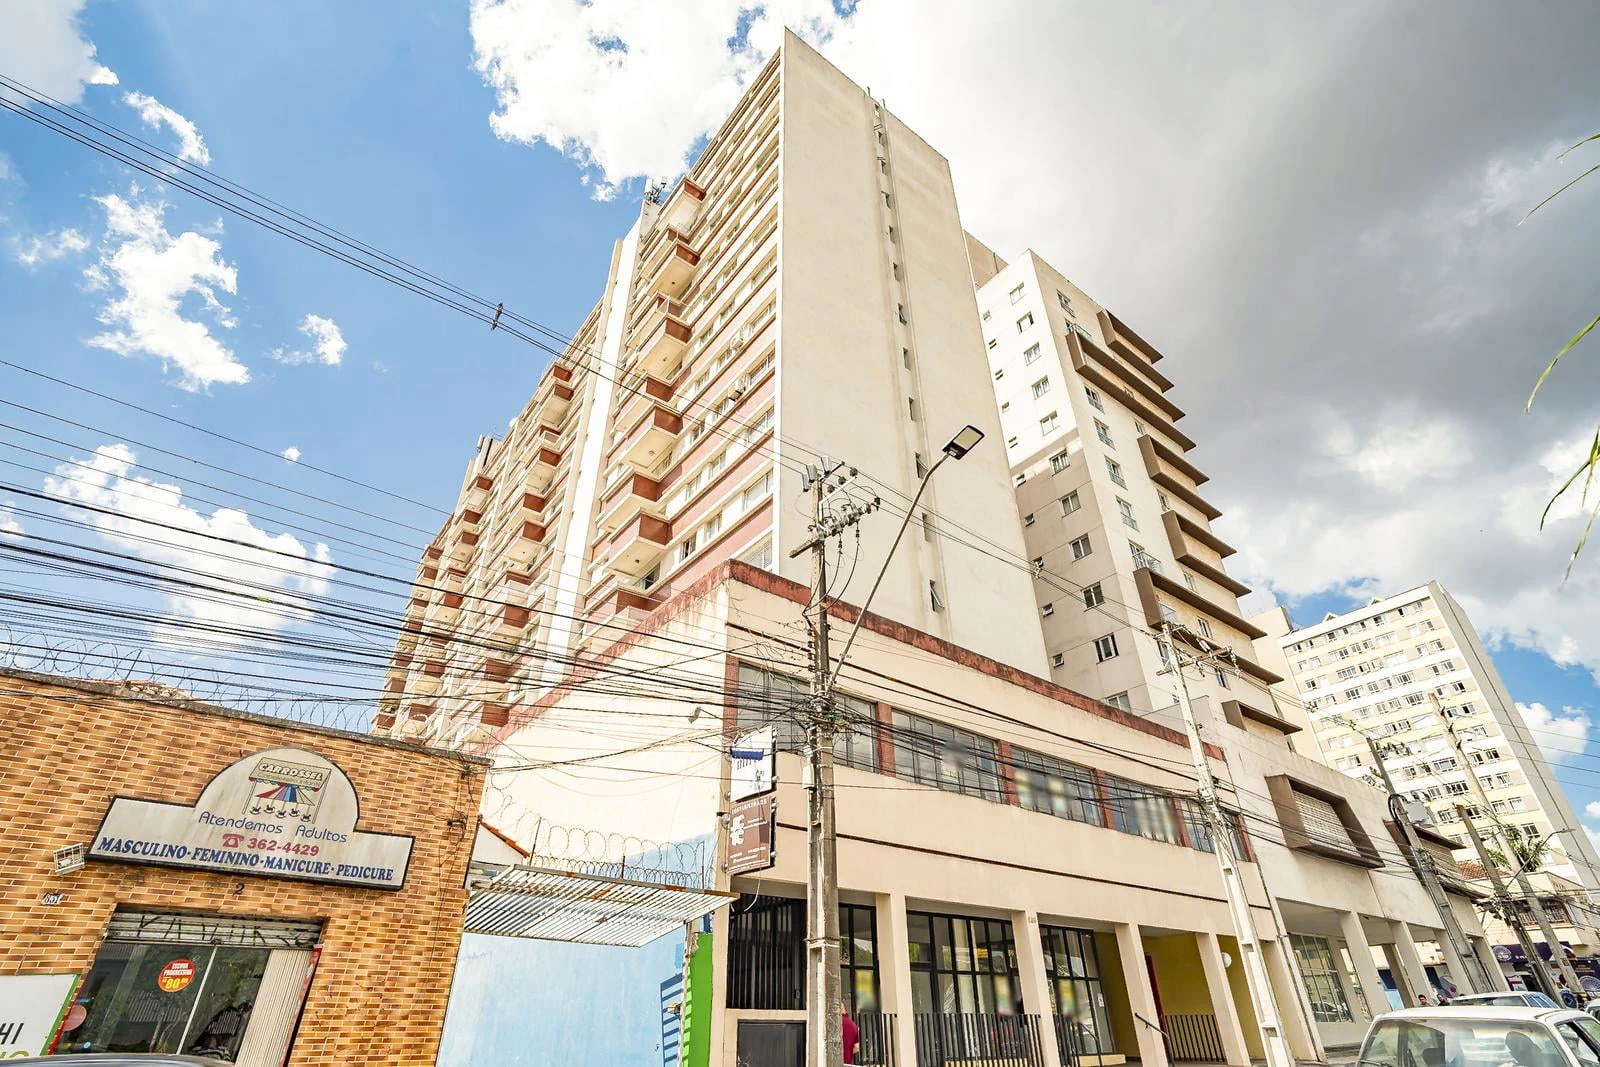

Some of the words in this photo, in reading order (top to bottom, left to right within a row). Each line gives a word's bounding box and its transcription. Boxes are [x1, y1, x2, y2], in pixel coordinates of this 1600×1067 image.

[258, 762, 323, 782] CARROSSEL
[198, 811, 284, 834] Atendemos
[295, 825, 348, 843] Adultos
[247, 837, 320, 857] 362-4429
[97, 836, 188, 859] MASCULINO
[191, 847, 260, 867] FEMININO
[263, 856, 331, 875] MANICURE
[336, 864, 394, 881] PEDICURE
[233, 882, 245, 895] 2
